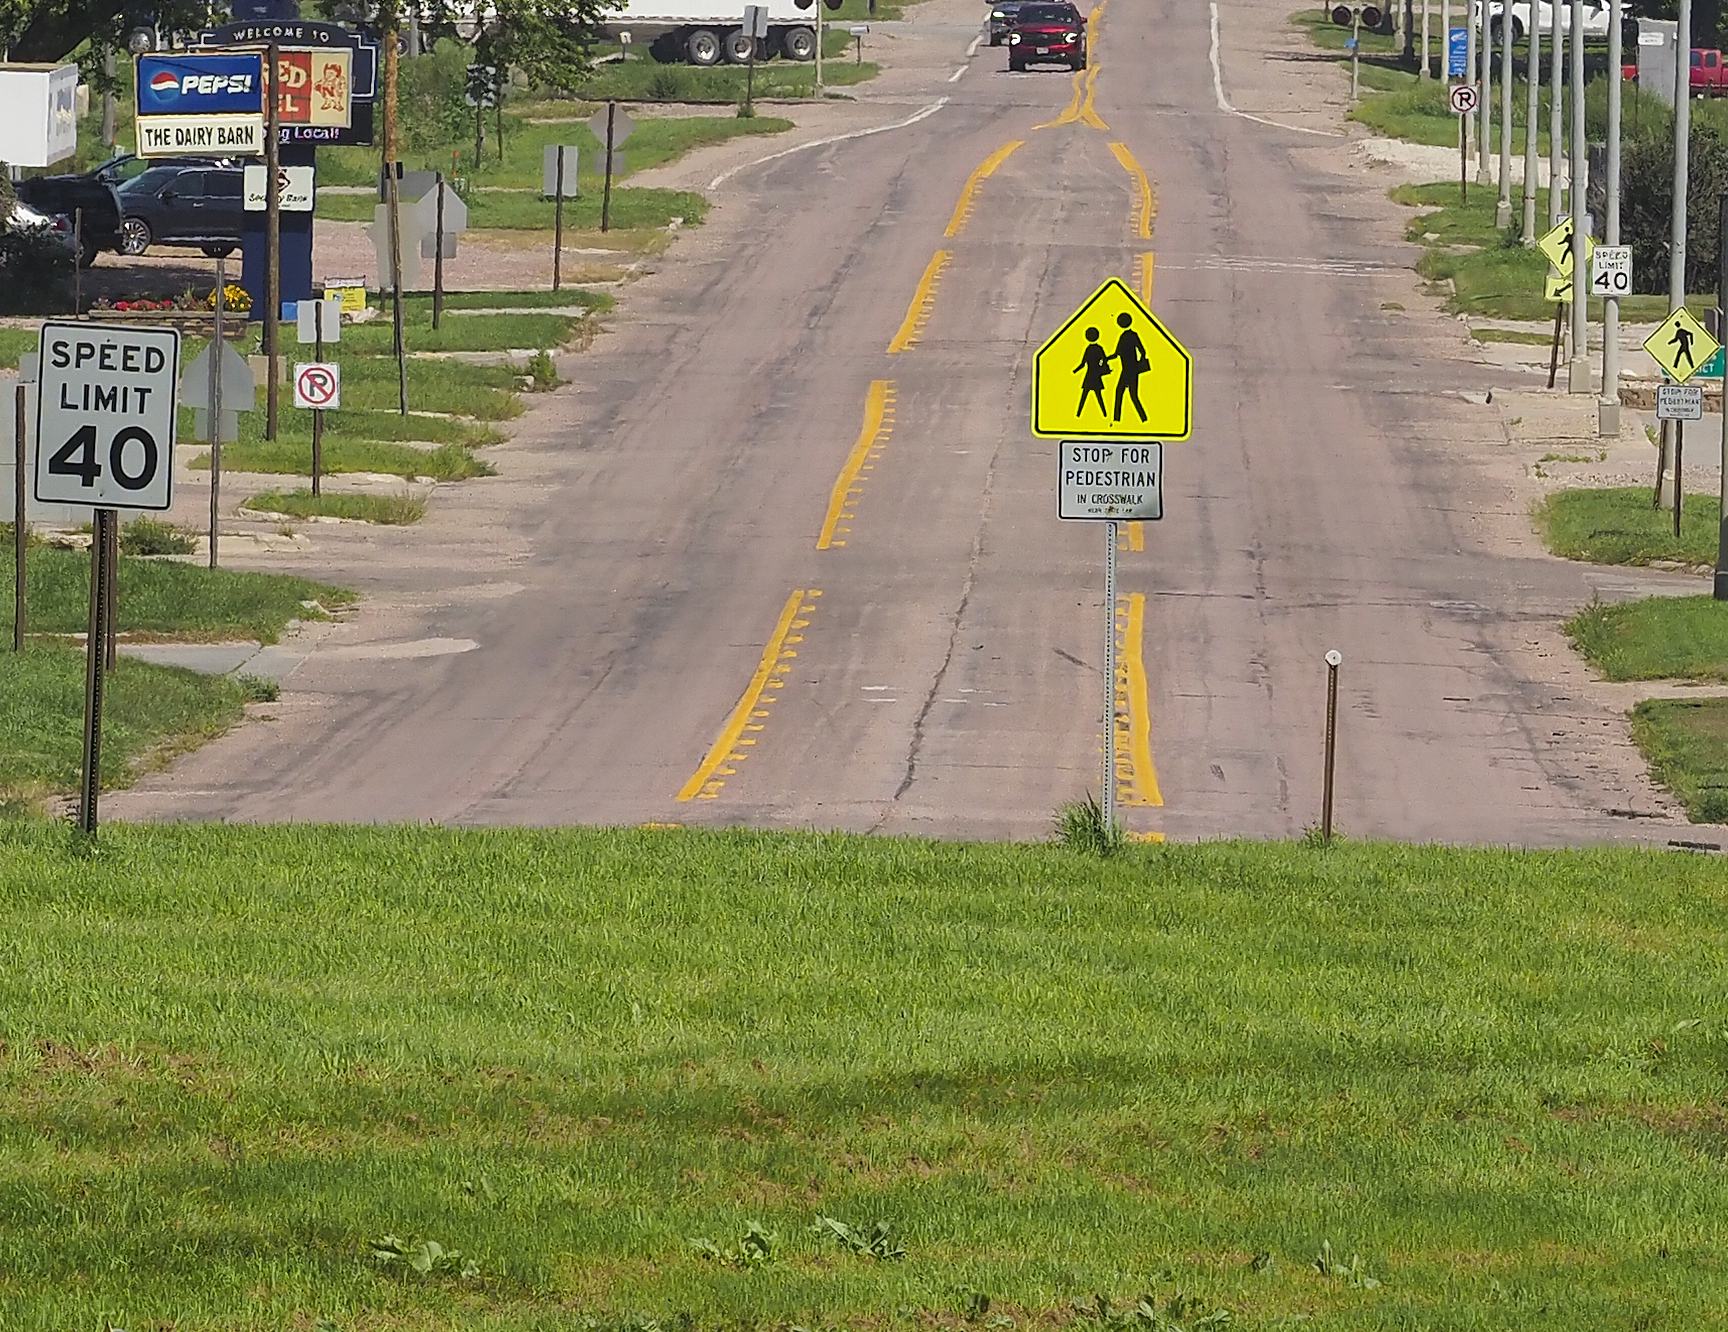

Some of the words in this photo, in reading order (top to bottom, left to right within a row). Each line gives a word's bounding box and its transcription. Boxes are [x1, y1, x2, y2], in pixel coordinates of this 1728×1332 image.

[233, 27, 303, 41] WELCOME
[145, 128, 171, 147] THE
[176, 127, 213, 147] DAIRY
[218, 126, 254, 146] BARN
[1595, 251, 1628, 260] SPEED
[1594, 271, 1628, 290] 40
[51, 341, 165, 373] SPEED
[61, 382, 153, 414] LIMIT
[49, 425, 158, 490] 40
[1072, 448, 1111, 463] STOP
[1121, 448, 1149, 463] FOR
[1065, 471, 1155, 487] PEDESTRIAN
[1077, 494, 1087, 504] IN
[1092, 494, 1143, 505] CROSSWALK
